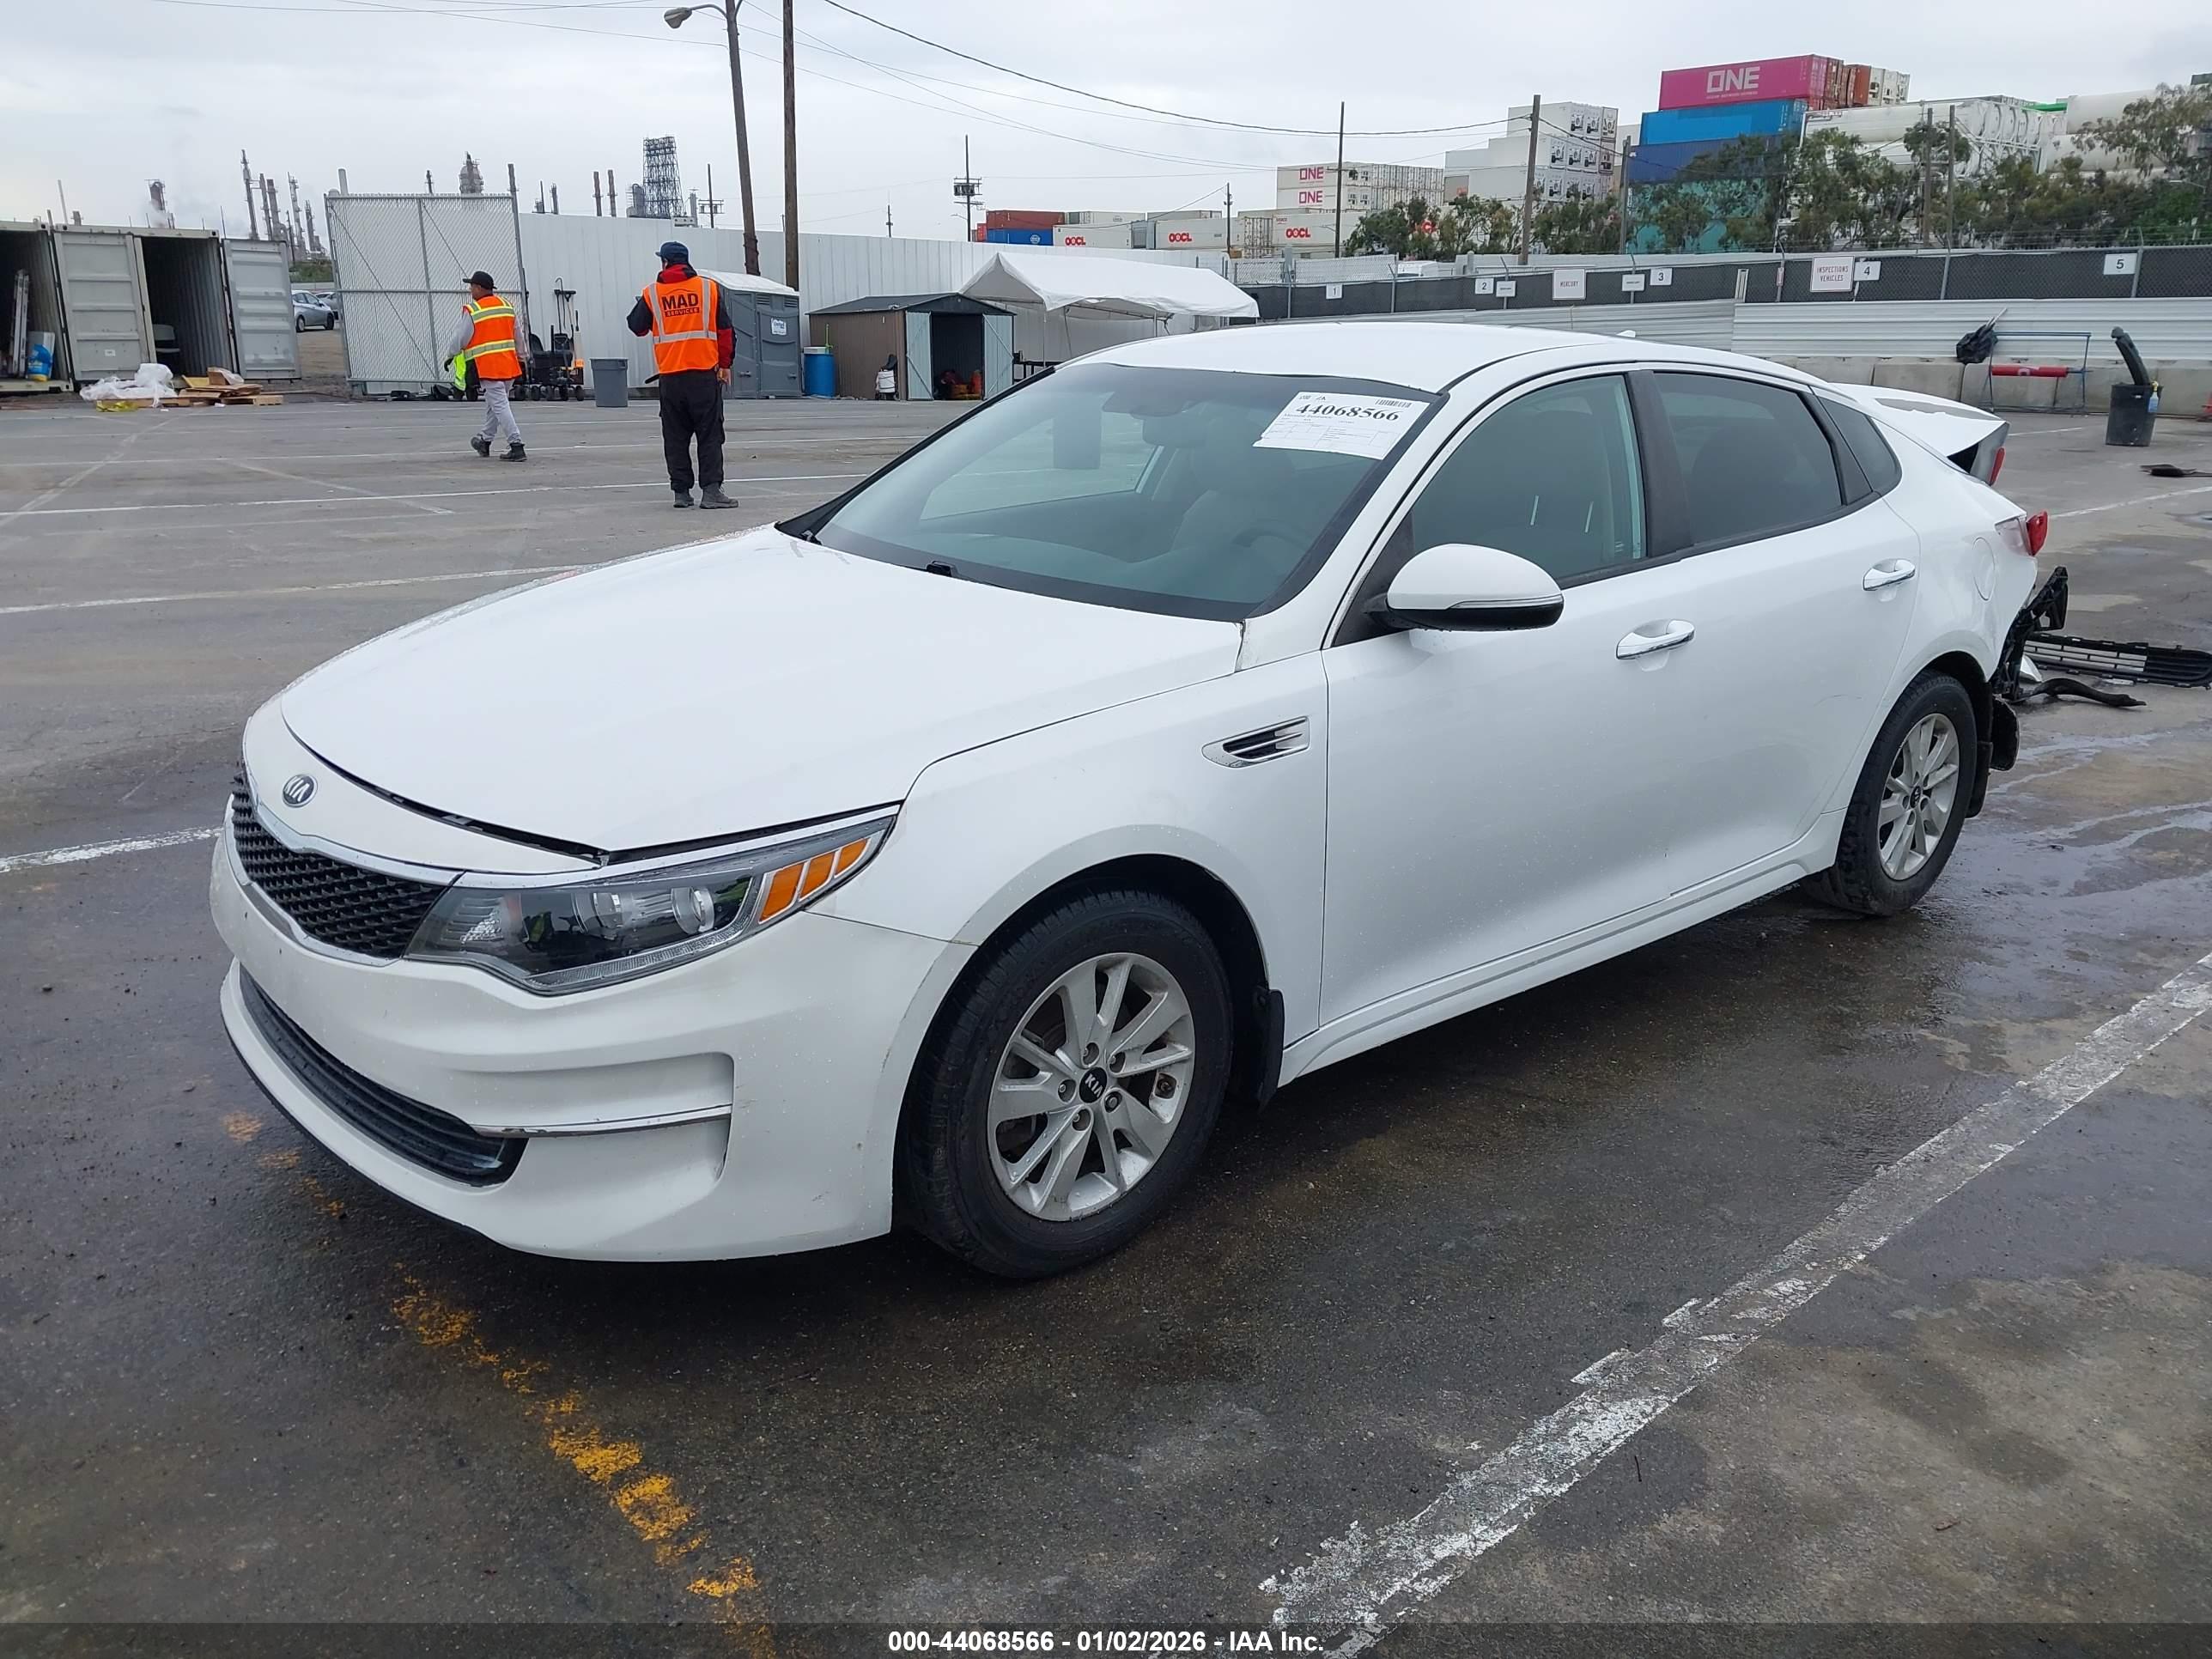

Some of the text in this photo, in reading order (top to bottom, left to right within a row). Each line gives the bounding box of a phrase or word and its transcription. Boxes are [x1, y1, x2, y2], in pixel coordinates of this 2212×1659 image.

[1706, 66, 1760, 94] ONE
[1299, 167, 1324, 180] ONE
[1298, 191, 1323, 204] ONE
[1169, 232, 1193, 242] OOCL
[1285, 227, 1311, 239] OOCL
[1065, 236, 1086, 246] OOCL
[2115, 258, 2125, 270] 5
[1658, 272, 1664, 282] 3
[1863, 266, 1870, 276] 4
[1481, 282, 1487, 290] 2
[660, 293, 699, 311] MAD
[665, 307, 700, 317] SERVICES
[1296, 404, 1401, 421] 44068566
[283, 775, 310, 803] KIA
[1085, 1073, 1103, 1098] KIA
